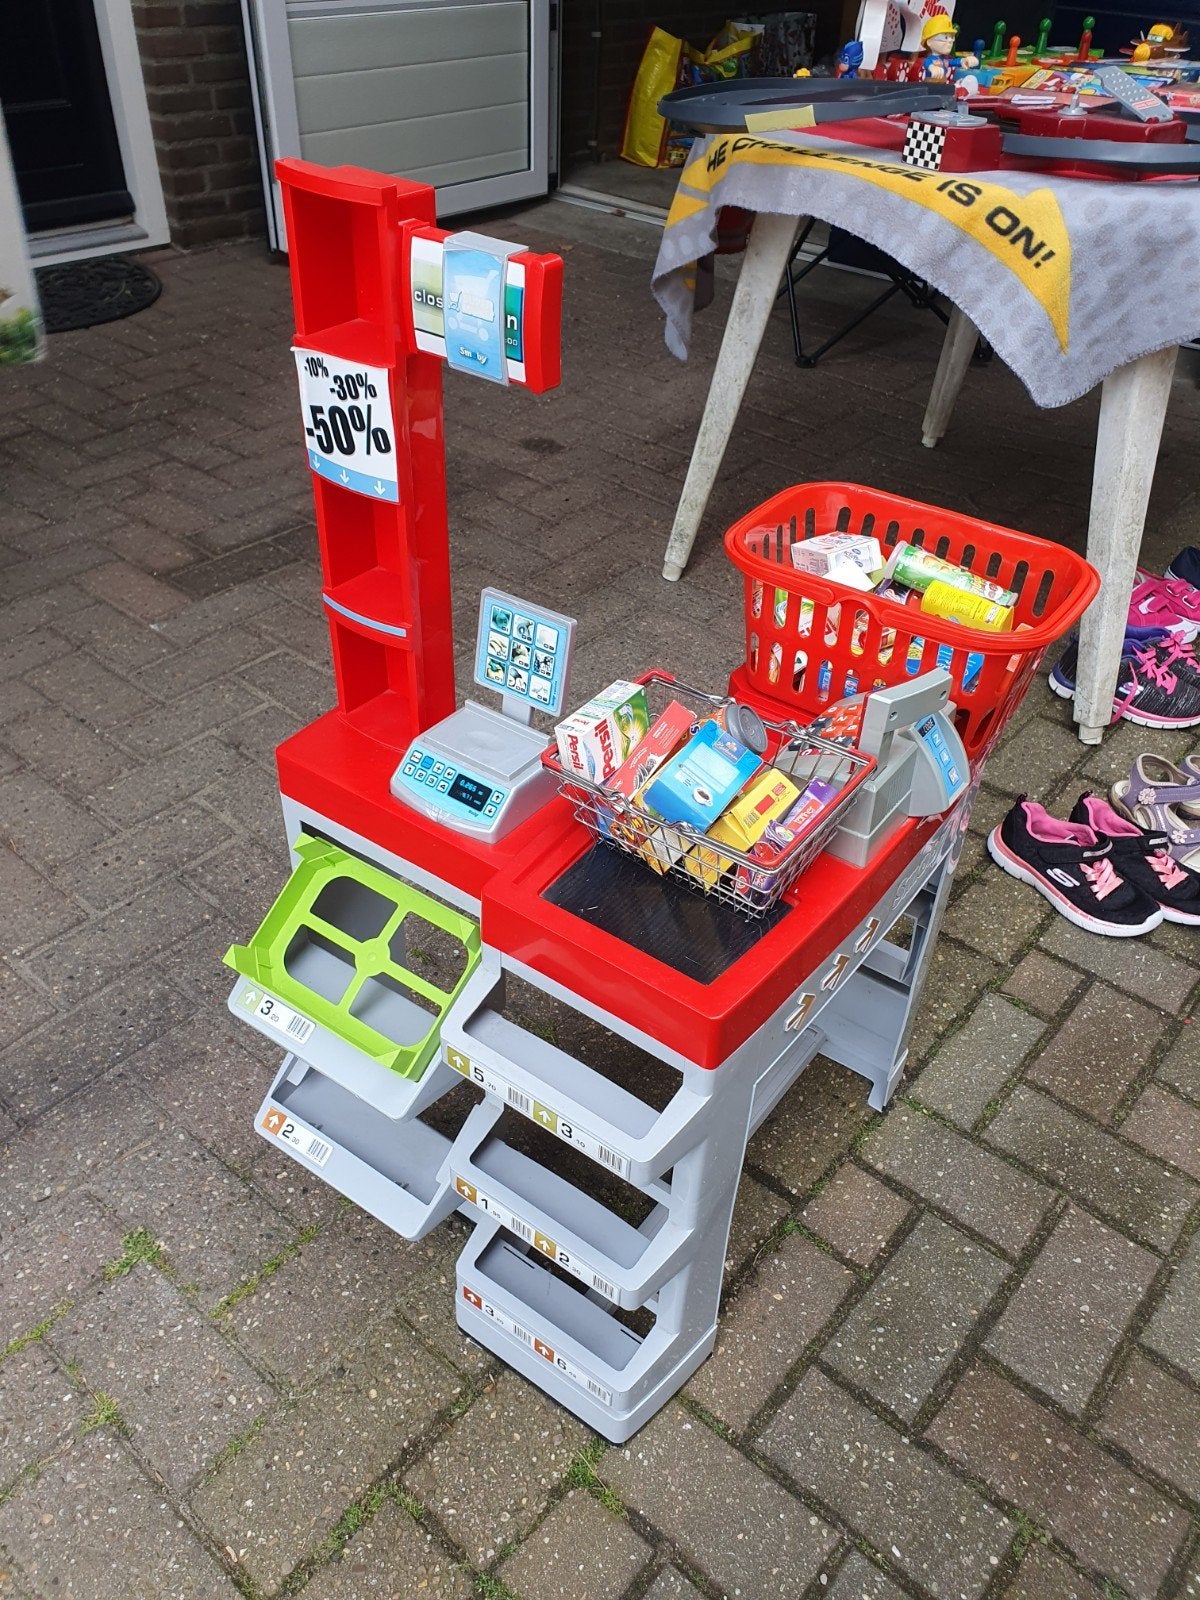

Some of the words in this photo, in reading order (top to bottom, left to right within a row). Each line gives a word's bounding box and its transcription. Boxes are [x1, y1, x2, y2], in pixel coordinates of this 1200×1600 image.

[732, 137, 935, 182] CHALLENGE
[936, 179, 982, 207] IS
[985, 205, 1056, 268] ON!
[304, 356, 329, 378] -10%
[329, 372, 378, 401] -30%
[306, 404, 391, 455] -50%
[567, 733, 584, 770] Persil
[594, 718, 616, 779] Persil
